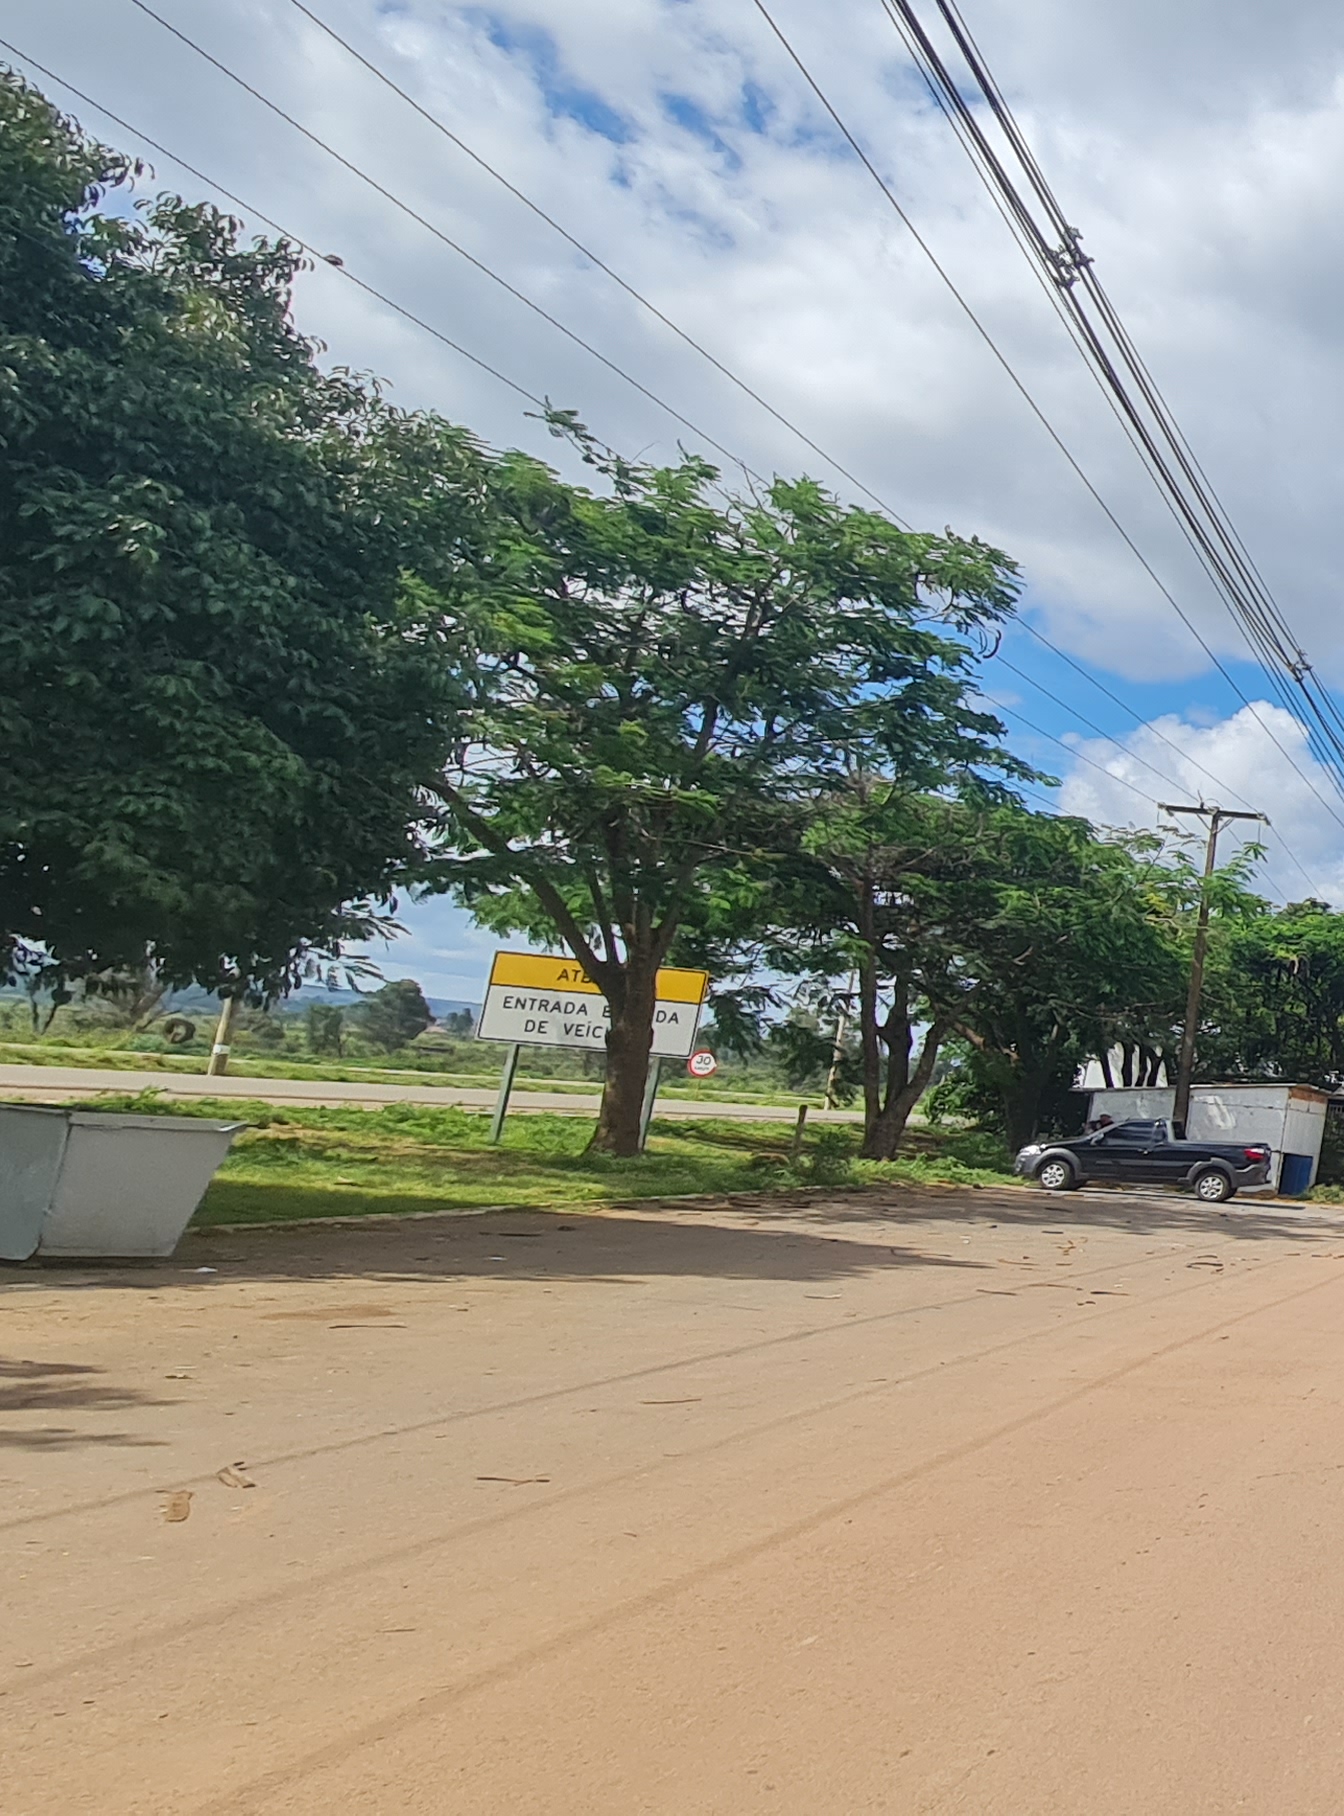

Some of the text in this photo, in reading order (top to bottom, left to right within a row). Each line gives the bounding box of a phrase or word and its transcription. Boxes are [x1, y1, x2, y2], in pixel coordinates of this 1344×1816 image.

[503, 996, 588, 1017] ENTRADA
[524, 1019, 611, 1039] DE VEÍC
